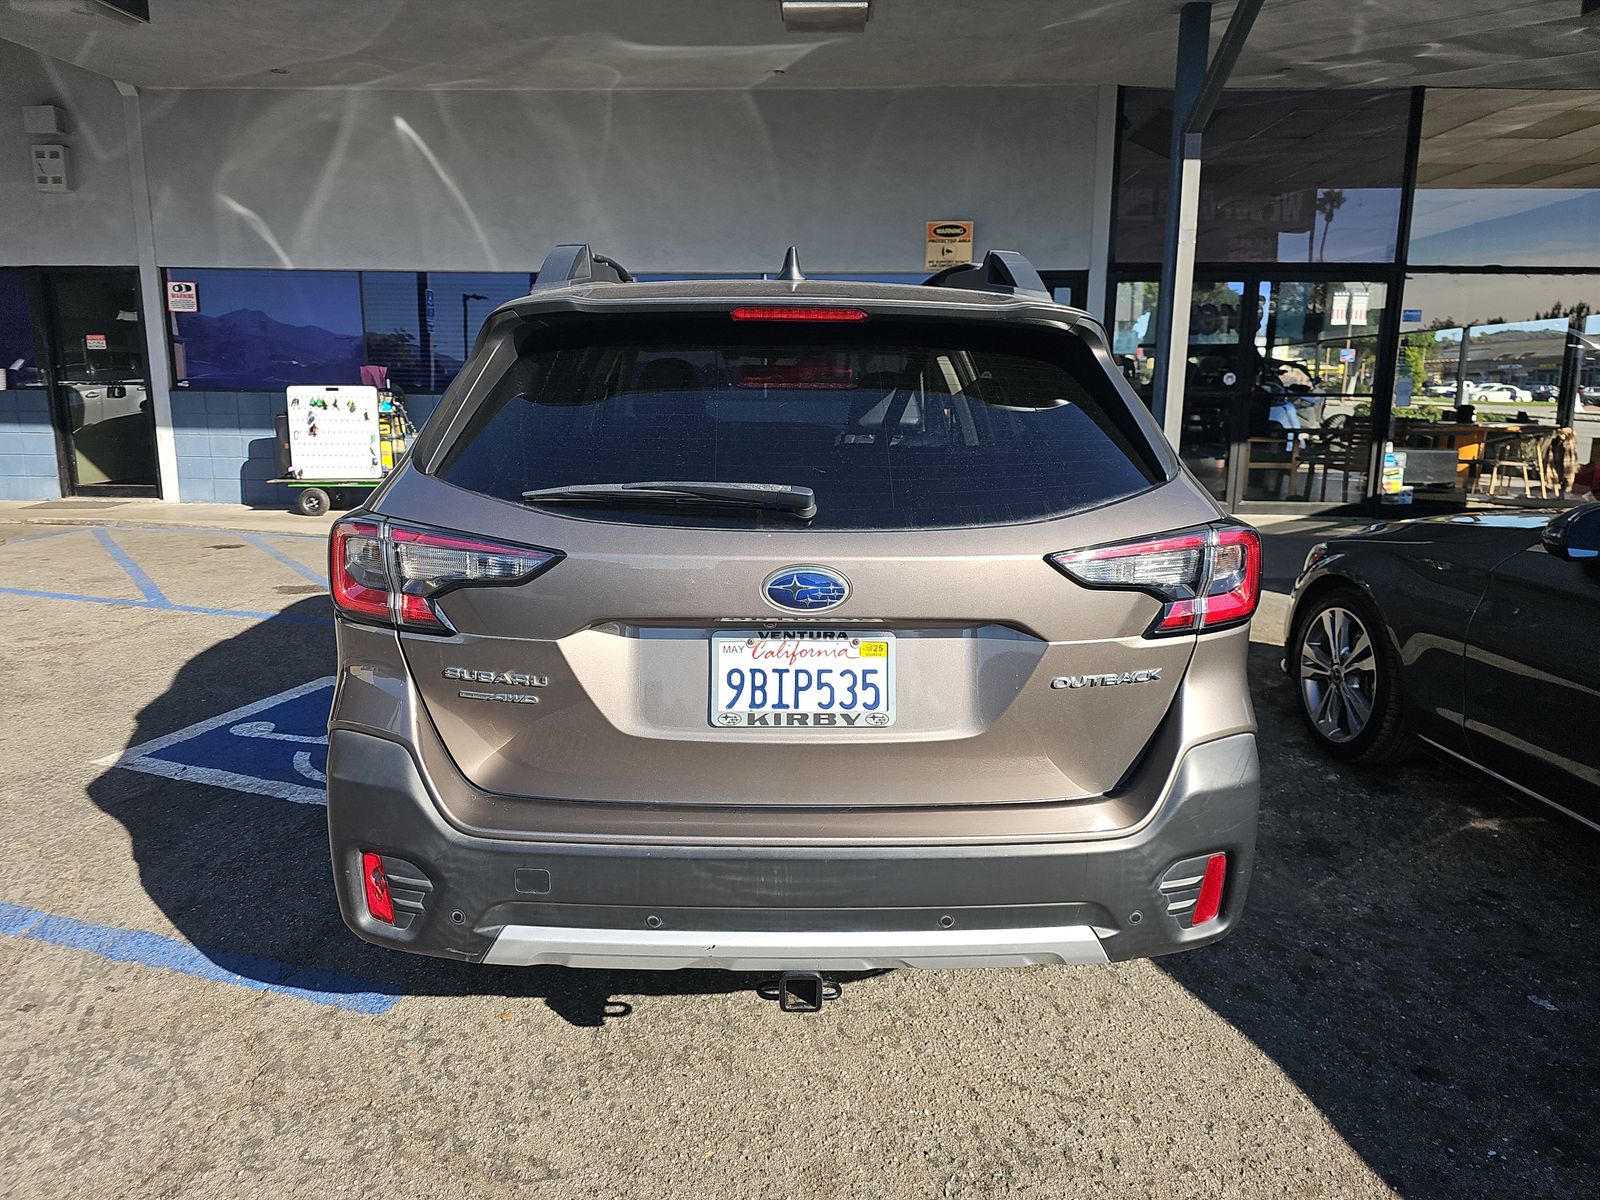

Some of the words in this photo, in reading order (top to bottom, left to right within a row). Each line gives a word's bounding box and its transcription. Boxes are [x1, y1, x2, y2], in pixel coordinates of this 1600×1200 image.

[757, 631, 850, 641] VENTURA
[722, 645, 745, 654] MAY
[751, 640, 860, 666] California
[873, 644, 884, 652] 25
[443, 666, 549, 687] SUBARU
[1050, 667, 1163, 689] OUTBACK
[726, 668, 881, 710] 9BIP535
[747, 712, 862, 726] KIRBY
